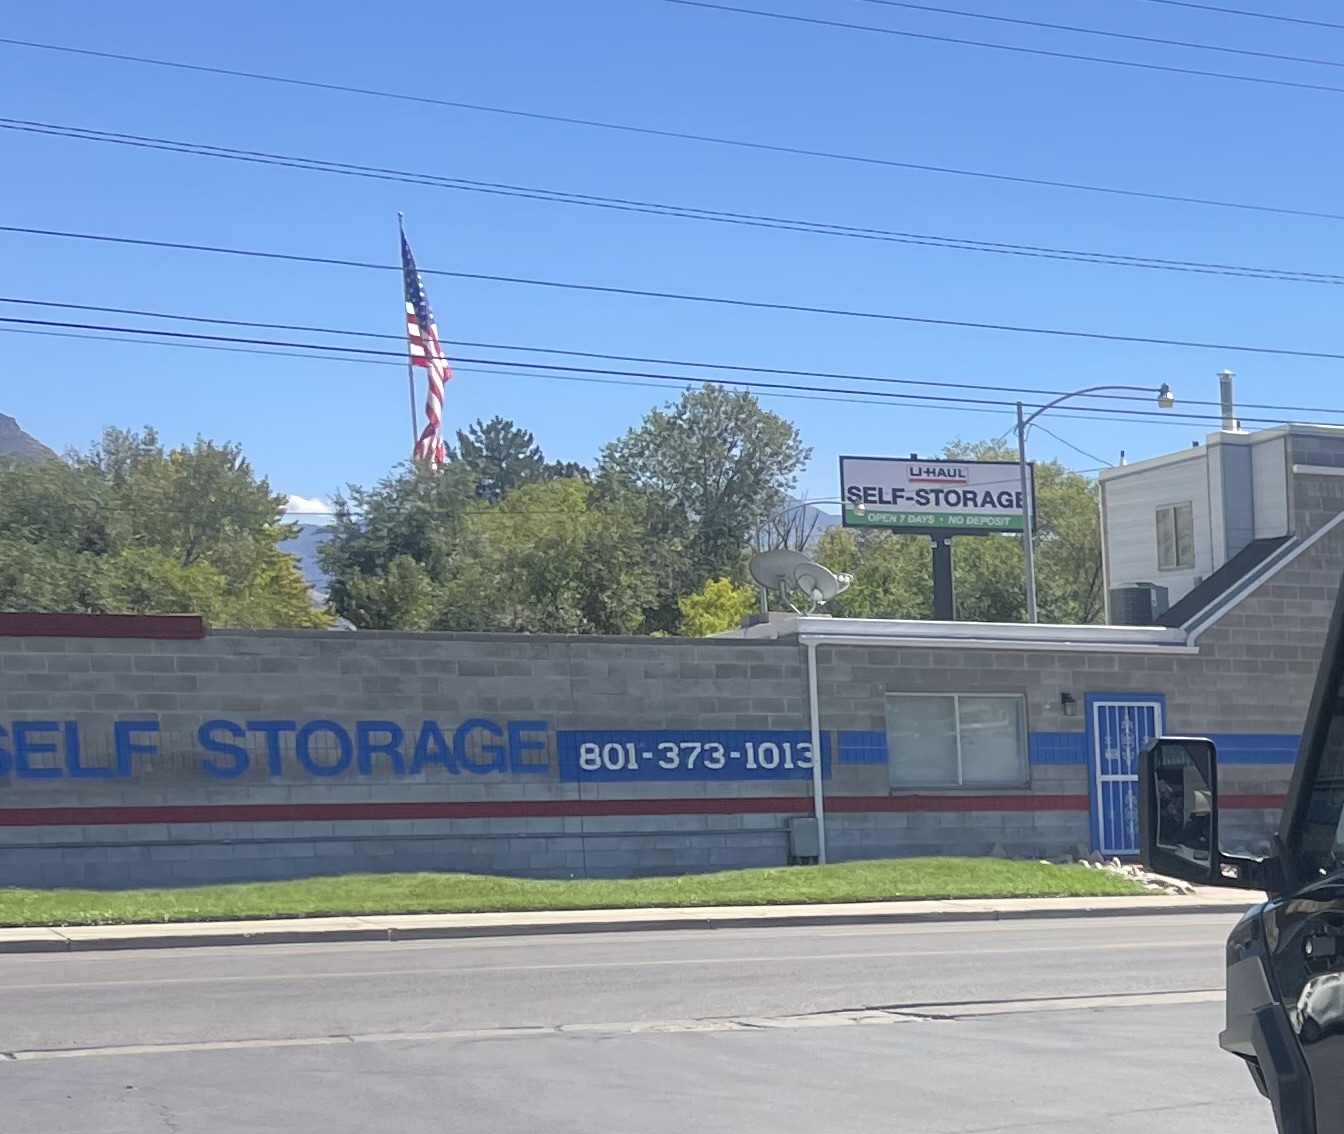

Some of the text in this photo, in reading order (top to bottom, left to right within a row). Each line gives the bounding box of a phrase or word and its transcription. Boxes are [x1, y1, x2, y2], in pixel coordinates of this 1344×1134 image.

[910, 467, 966, 478] U-HAUL
[868, 513, 1011, 526] OPEN 7 DAYS NO DEPOSIT
[0, 718, 549, 779] ELF STORAGE
[579, 742, 815, 770] 801-373-1013
